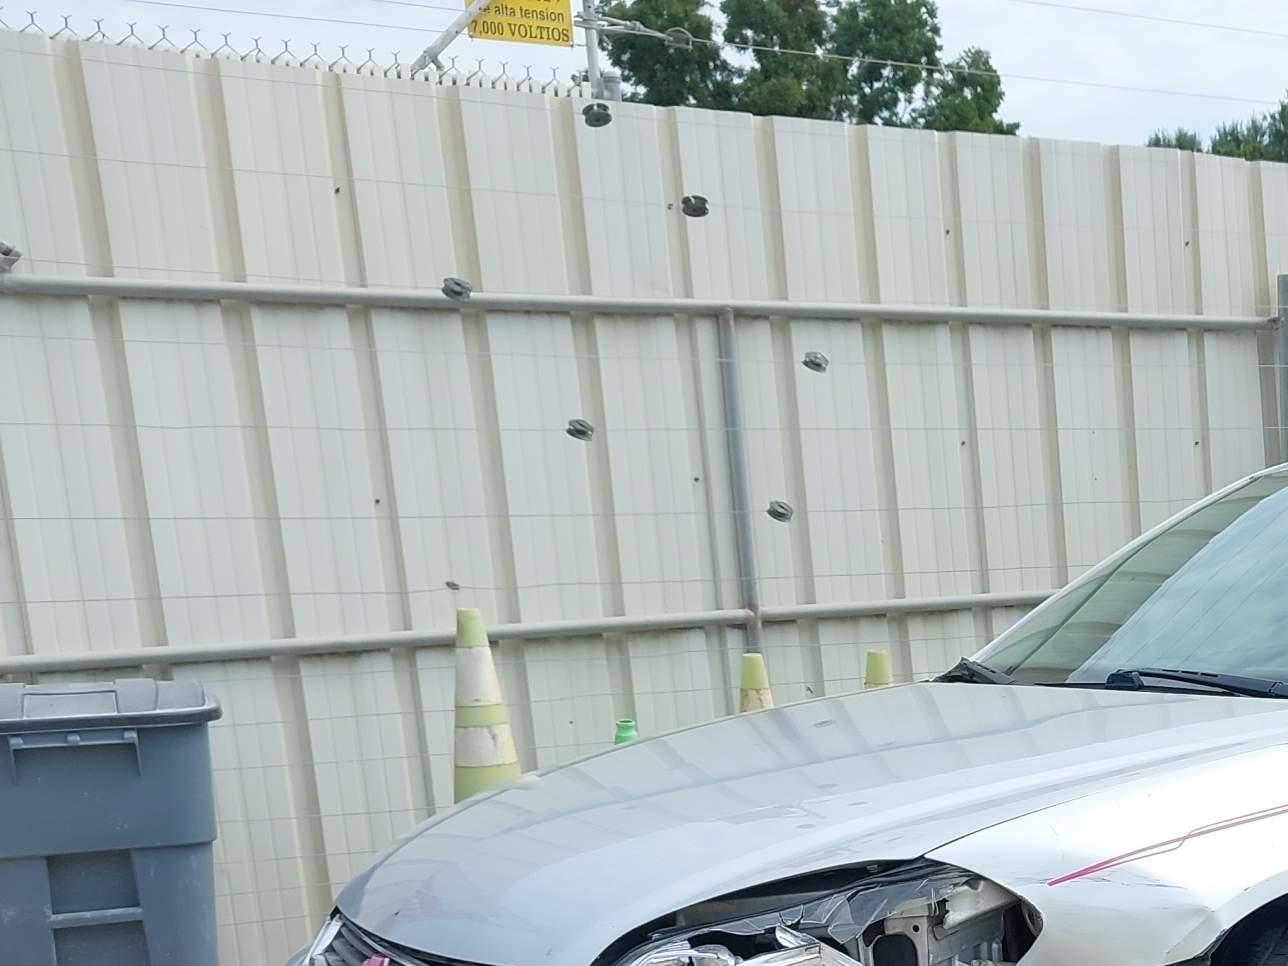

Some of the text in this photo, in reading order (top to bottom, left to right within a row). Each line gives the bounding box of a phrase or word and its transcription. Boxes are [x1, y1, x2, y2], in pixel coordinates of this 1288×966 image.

[494, 4, 516, 17] alta
[520, 6, 565, 23] tension
[472, 19, 570, 42] 7,000 VOLTIOS
